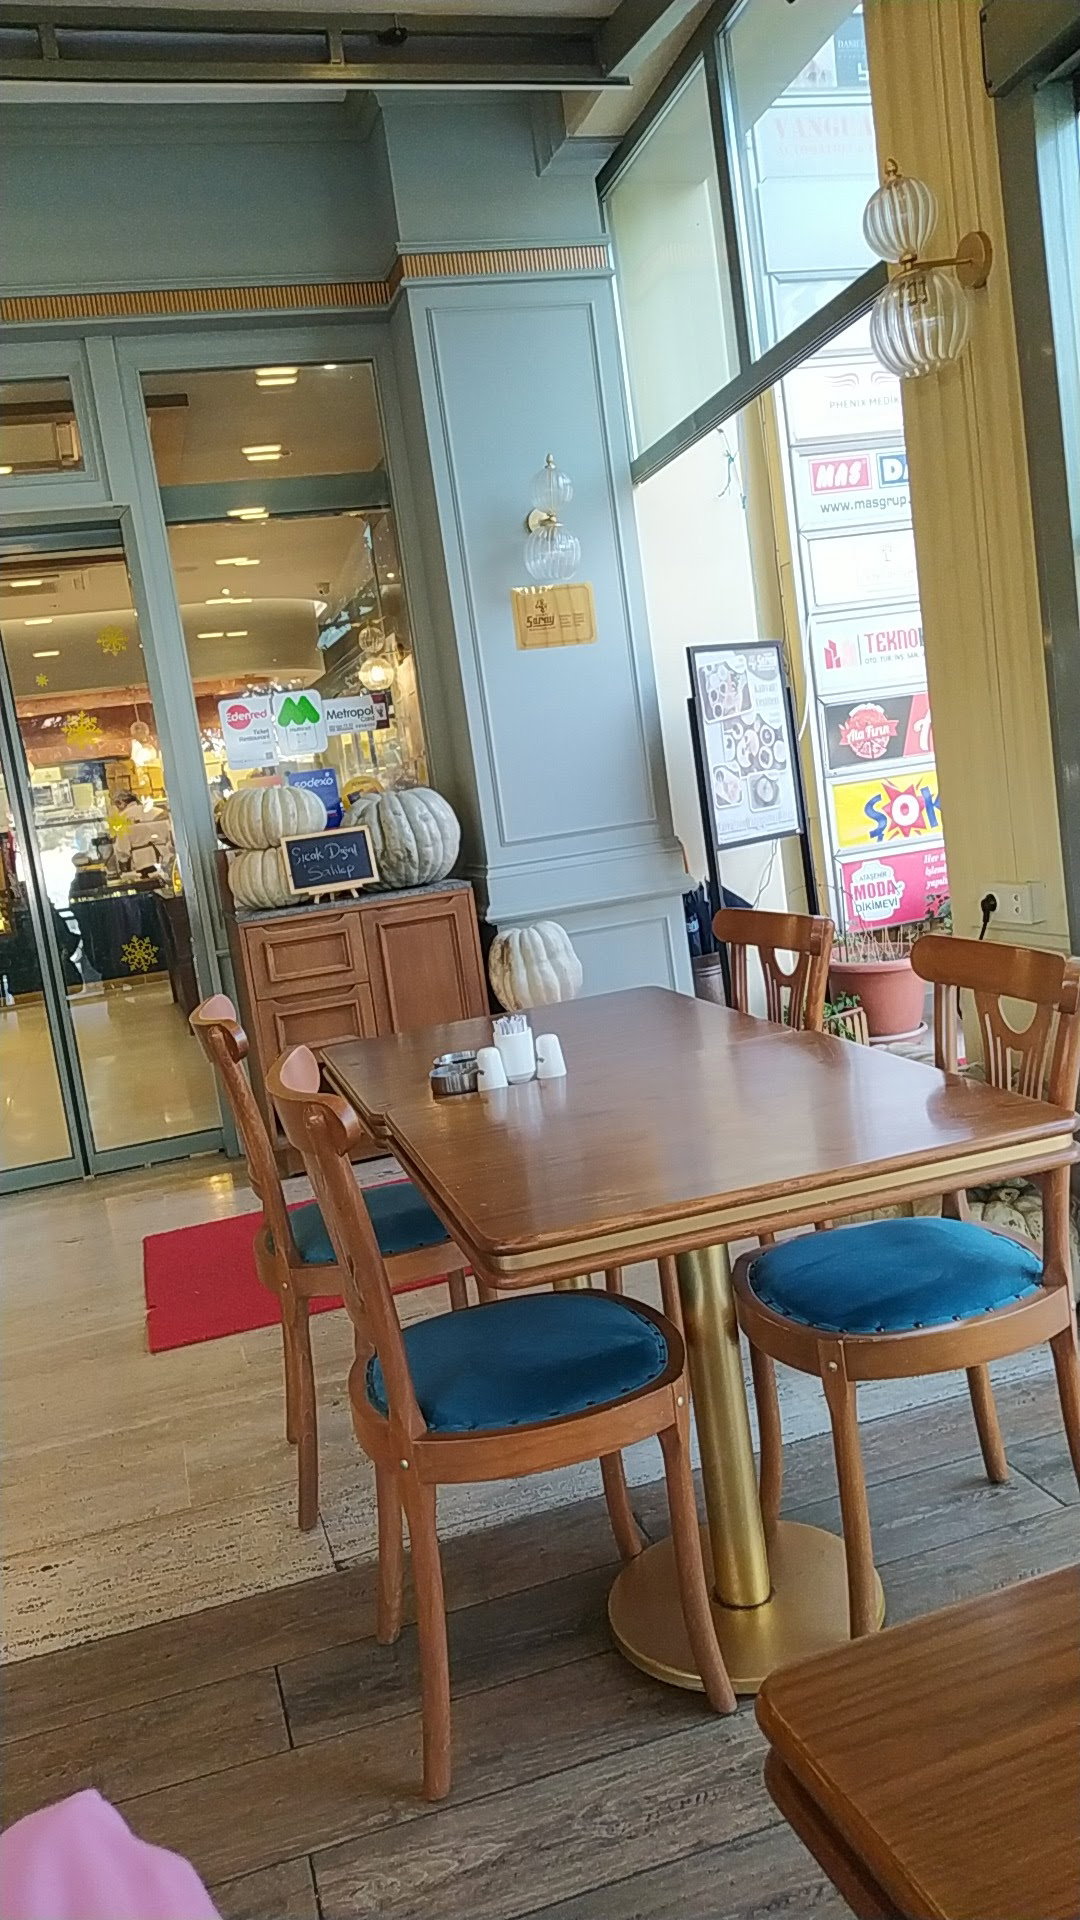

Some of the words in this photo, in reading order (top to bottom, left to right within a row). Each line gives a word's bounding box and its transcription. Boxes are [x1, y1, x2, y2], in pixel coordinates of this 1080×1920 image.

[815, 461, 862, 489] MAS
[526, 614, 555, 628] Saray
[226, 710, 268, 723] Edenred
[326, 705, 375, 721] Metropol
[853, 880, 897, 902] MODA
[855, 897, 900, 914] DİKİMEVİ
